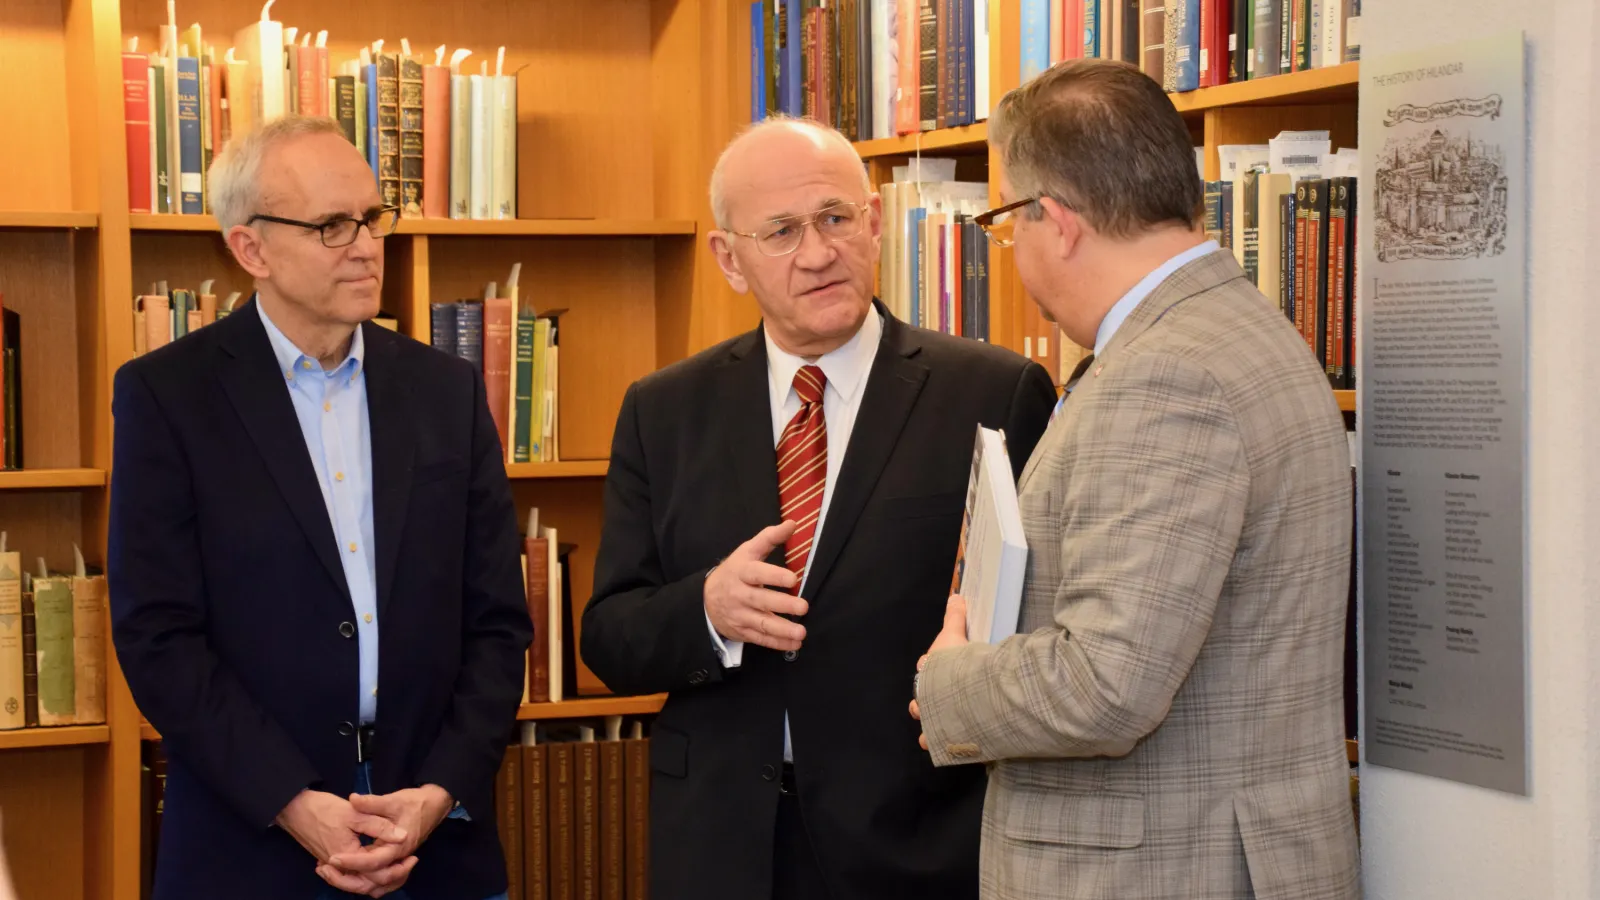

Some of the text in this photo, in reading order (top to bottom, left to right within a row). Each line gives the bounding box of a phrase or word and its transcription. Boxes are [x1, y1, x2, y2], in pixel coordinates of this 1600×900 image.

[1372, 61, 1464, 88] THE HISTORY OF HILANDAR
